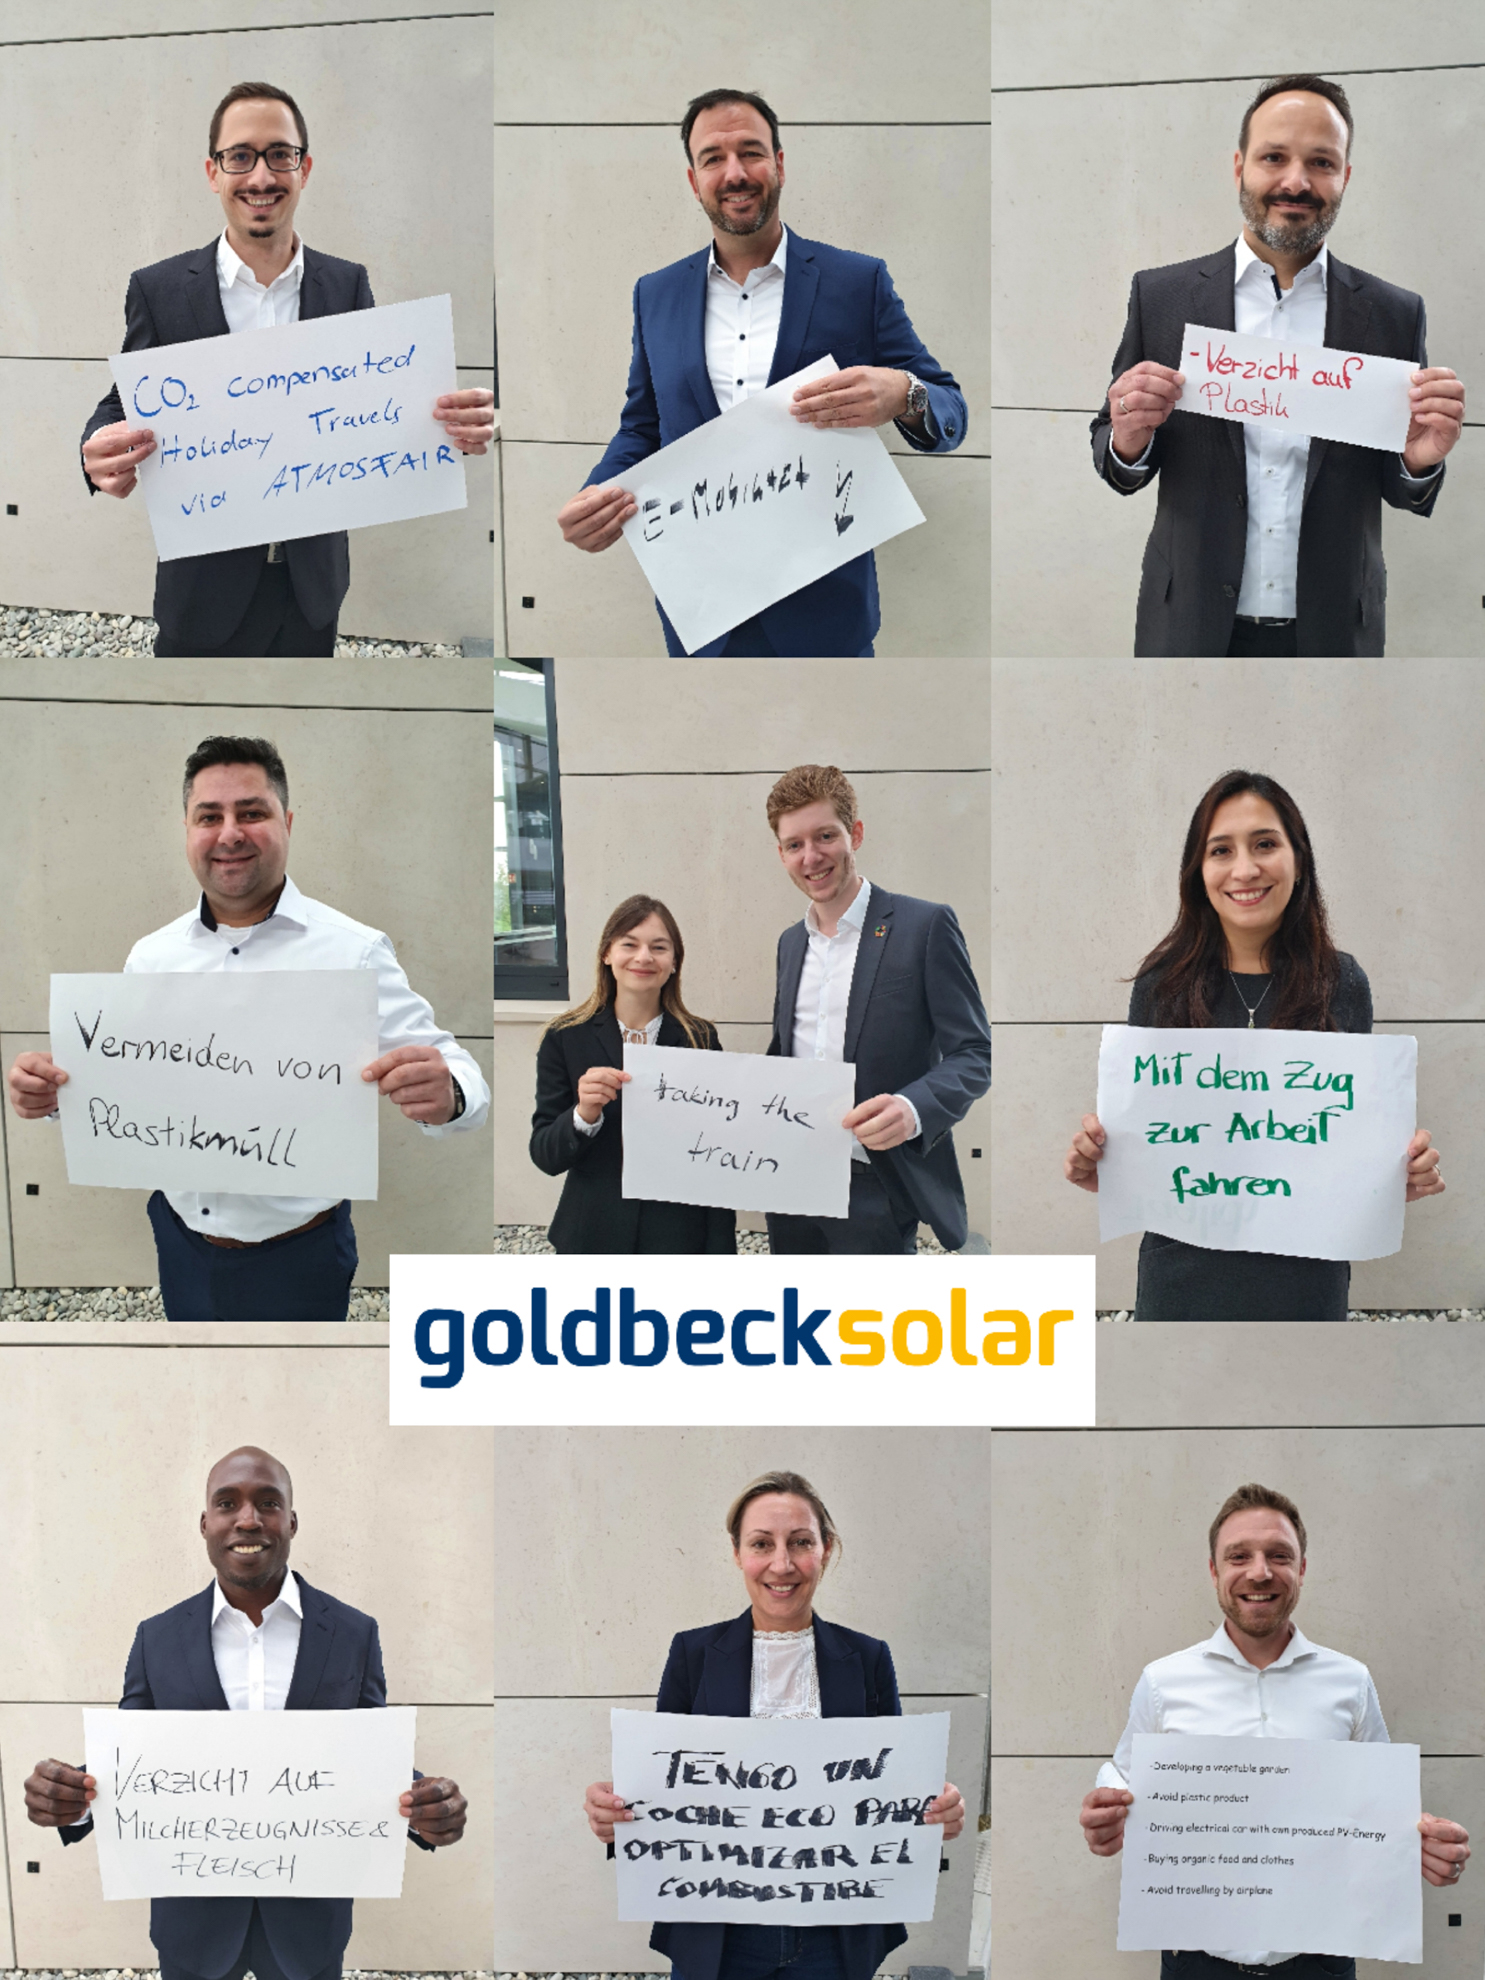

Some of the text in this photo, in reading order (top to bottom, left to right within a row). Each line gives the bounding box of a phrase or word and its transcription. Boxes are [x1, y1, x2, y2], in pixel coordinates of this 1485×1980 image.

[227, 344, 416, 398] compensated
[1312, 357, 1363, 390] auf
[1199, 382, 1289, 418] Plastik
[160, 430, 274, 468] Holiday
[181, 490, 227, 516] via
[74, 1010, 341, 1085] Vermeiden von
[1196, 1053, 1269, 1091] dem
[762, 1094, 815, 1130] the
[1145, 1122, 1212, 1144] zur
[688, 1131, 779, 1173] train
[1170, 1165, 1292, 1204] fahren
[268, 1767, 336, 1796] AUF
[652, 1749, 797, 1790] TENGO
[1213, 1794, 1249, 1804] product
[762, 1804, 836, 1828] ECO
[1186, 1823, 1230, 1833] electrical
[1232, 1826, 1248, 1834] car
[1249, 1824, 1270, 1834] with
[1291, 1827, 1335, 1837] produced
[171, 1852, 296, 1883] FLEISCH
[1181, 1855, 1215, 1866] organic
[1217, 1853, 1240, 1864] food
[1241, 1854, 1258, 1864] and
[1260, 1855, 1295, 1866] clothes
[1222, 1885, 1235, 1897] by
[1236, 1886, 1274, 1897] airplane
